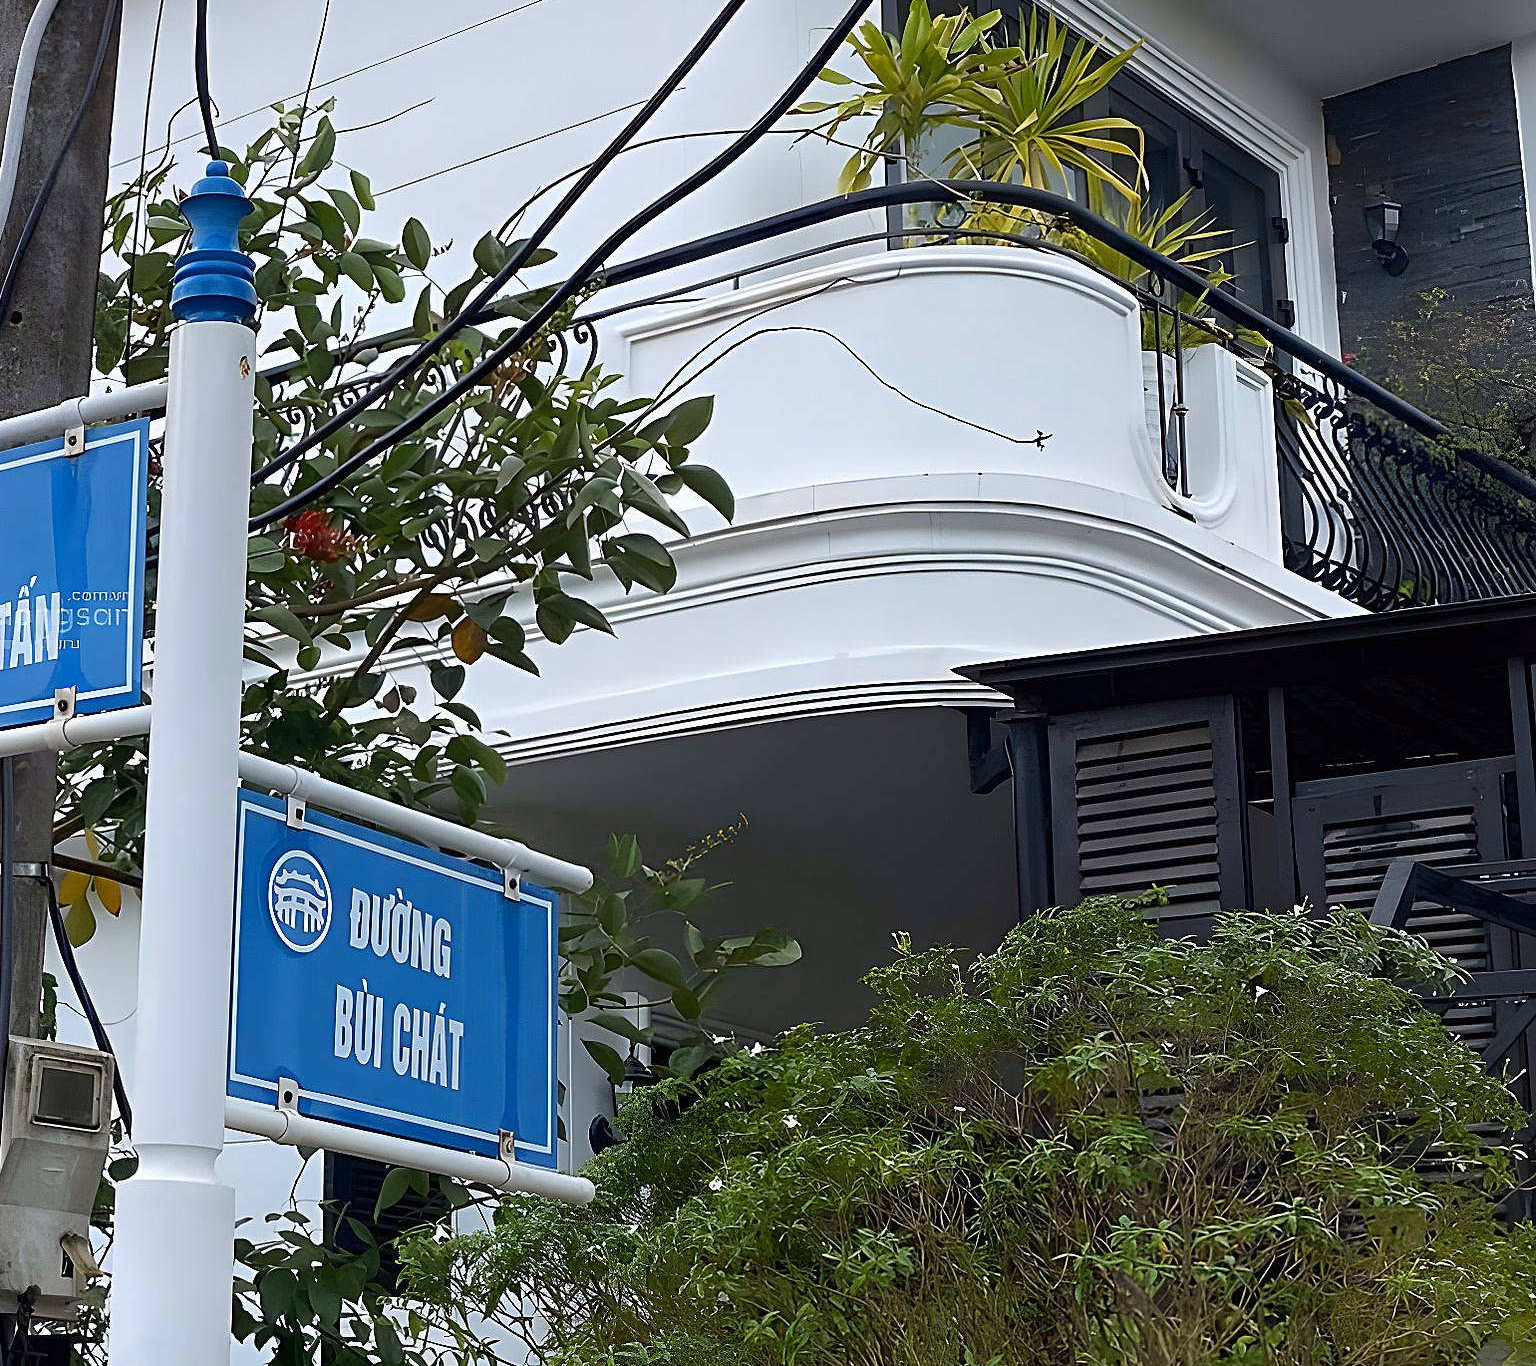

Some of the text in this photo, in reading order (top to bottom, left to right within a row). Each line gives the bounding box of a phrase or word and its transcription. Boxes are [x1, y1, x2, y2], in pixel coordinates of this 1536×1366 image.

[349, 886, 452, 979] ĐƯỜNG
[333, 977, 464, 1091] BÙI CHÁT
